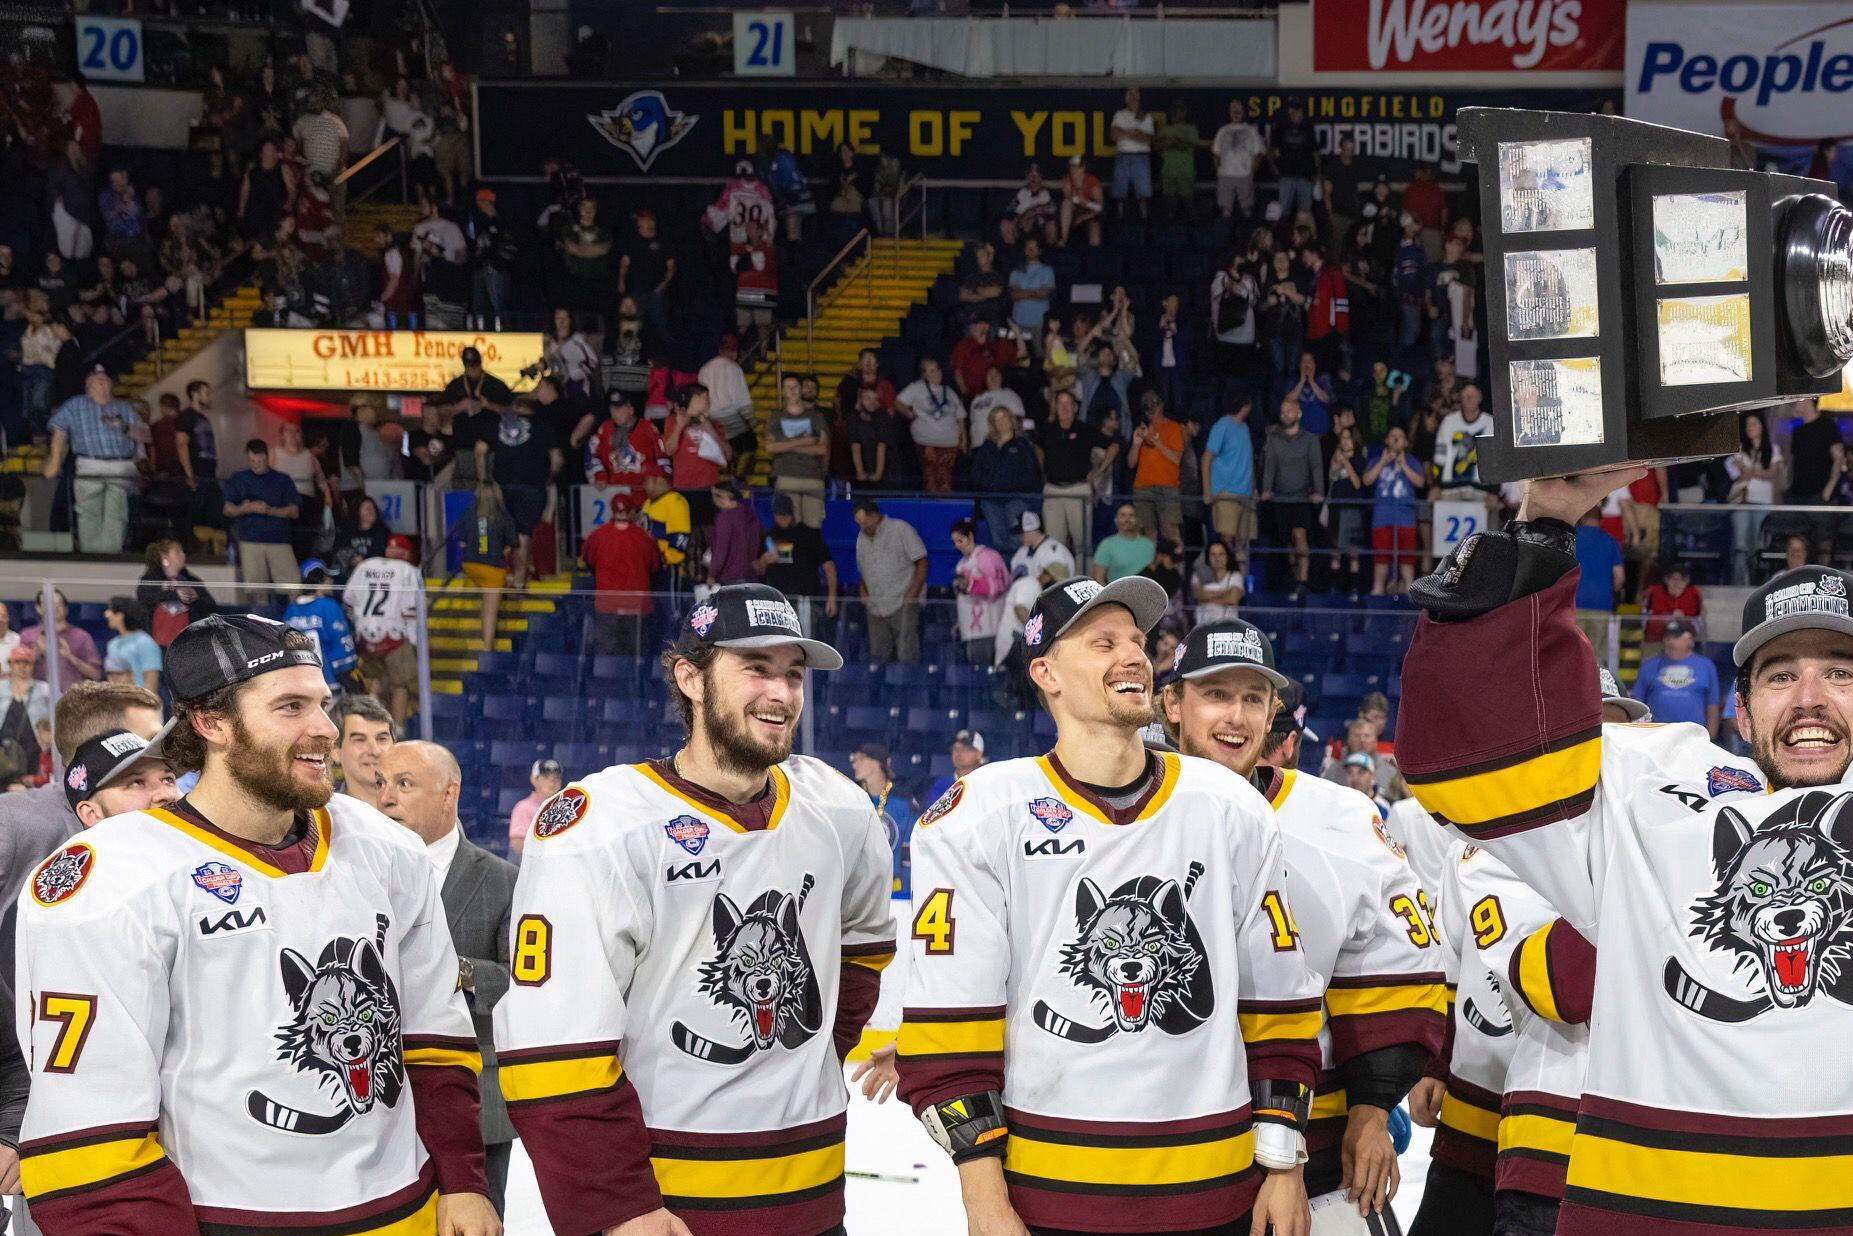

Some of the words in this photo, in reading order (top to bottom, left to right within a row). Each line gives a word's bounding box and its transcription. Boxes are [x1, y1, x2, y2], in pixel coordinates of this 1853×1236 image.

[84, 27, 138, 71] 20
[747, 21, 783, 66] 21
[1368, 0, 1583, 70] Wendys
[1249, 96, 1445, 118] SPINGFIELD
[723, 109, 880, 156] HOME
[909, 110, 981, 157] OF
[313, 330, 395, 360] GMH
[246, 650, 285, 669] CCM
[911, 888, 956, 956] 4
[512, 913, 553, 988] 8
[31, 990, 98, 1074] 7
